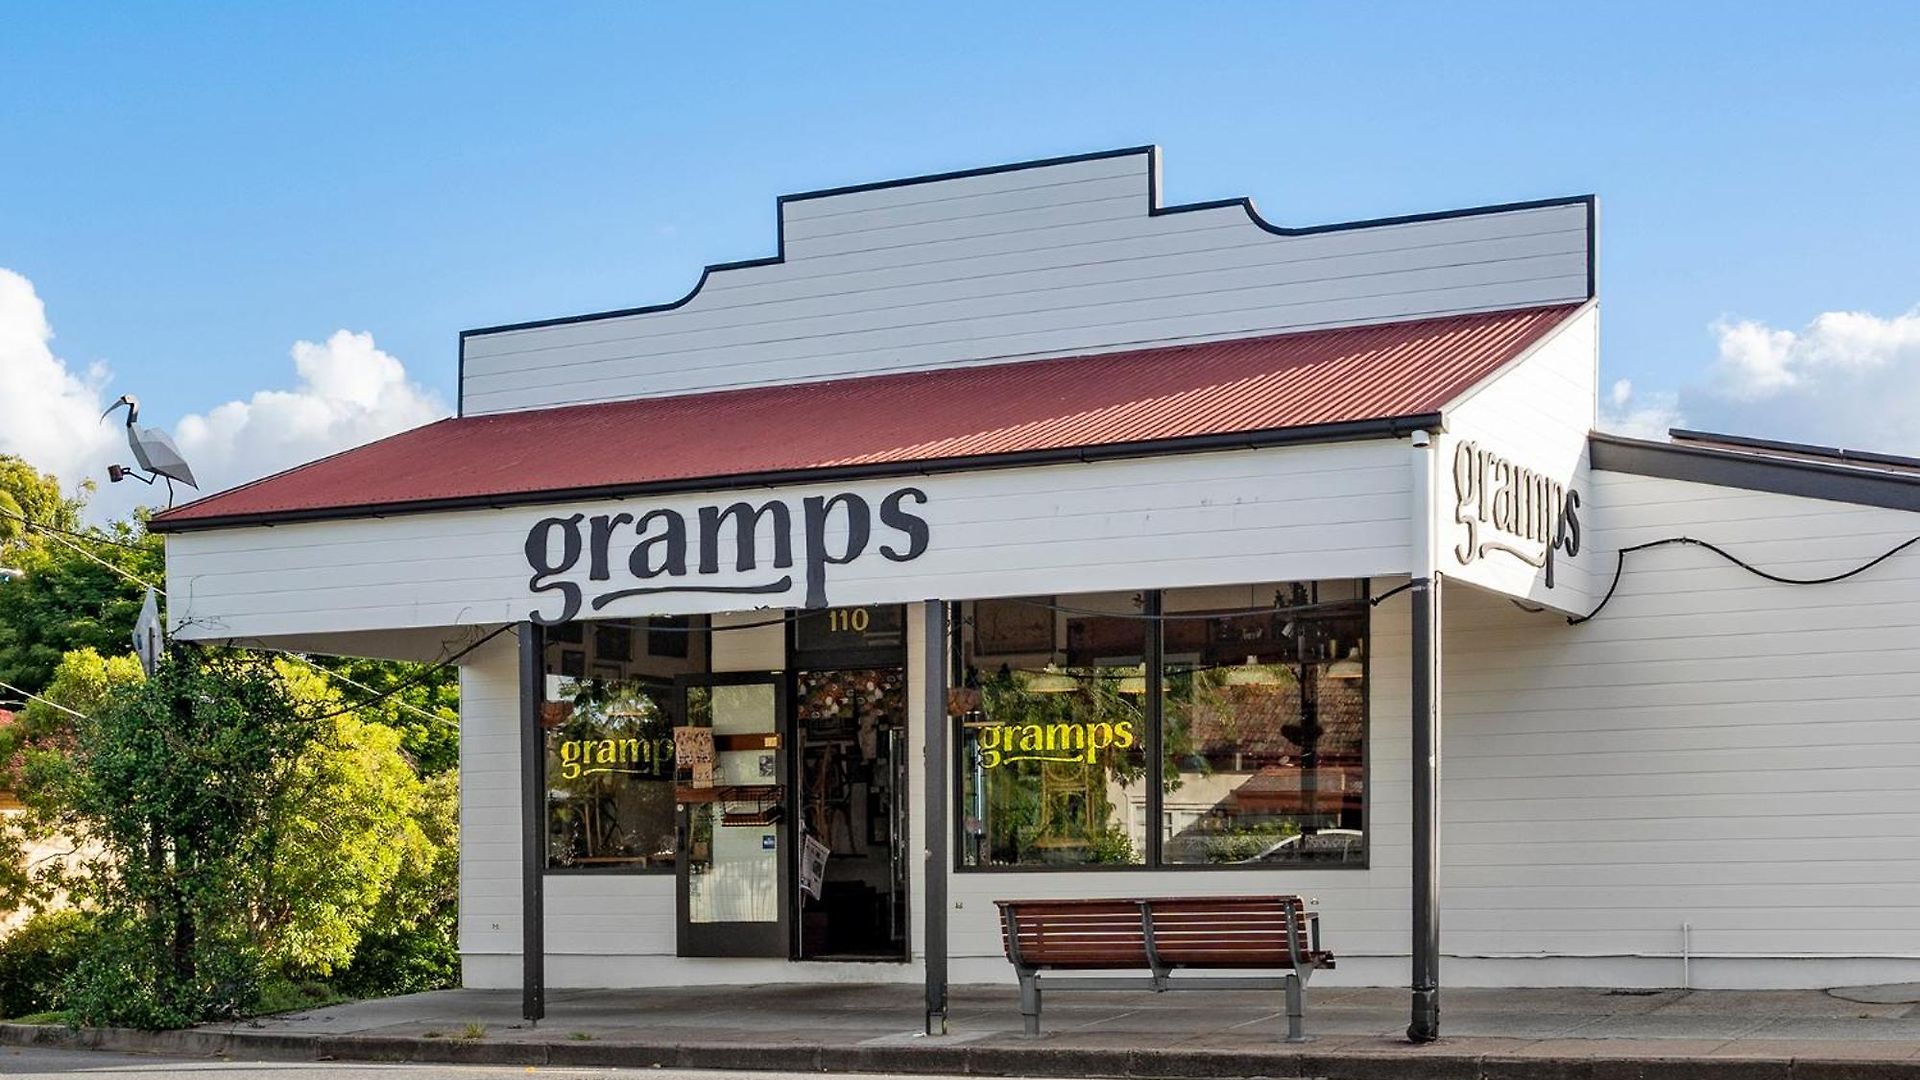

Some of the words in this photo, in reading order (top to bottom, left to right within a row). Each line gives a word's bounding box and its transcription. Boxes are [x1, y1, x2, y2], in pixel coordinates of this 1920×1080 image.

[1453, 439, 1581, 589] gramps
[524, 486, 930, 627] gramps
[829, 608, 869, 632] 110
[560, 738, 676, 779] gramp
[978, 721, 1134, 769] gramps
